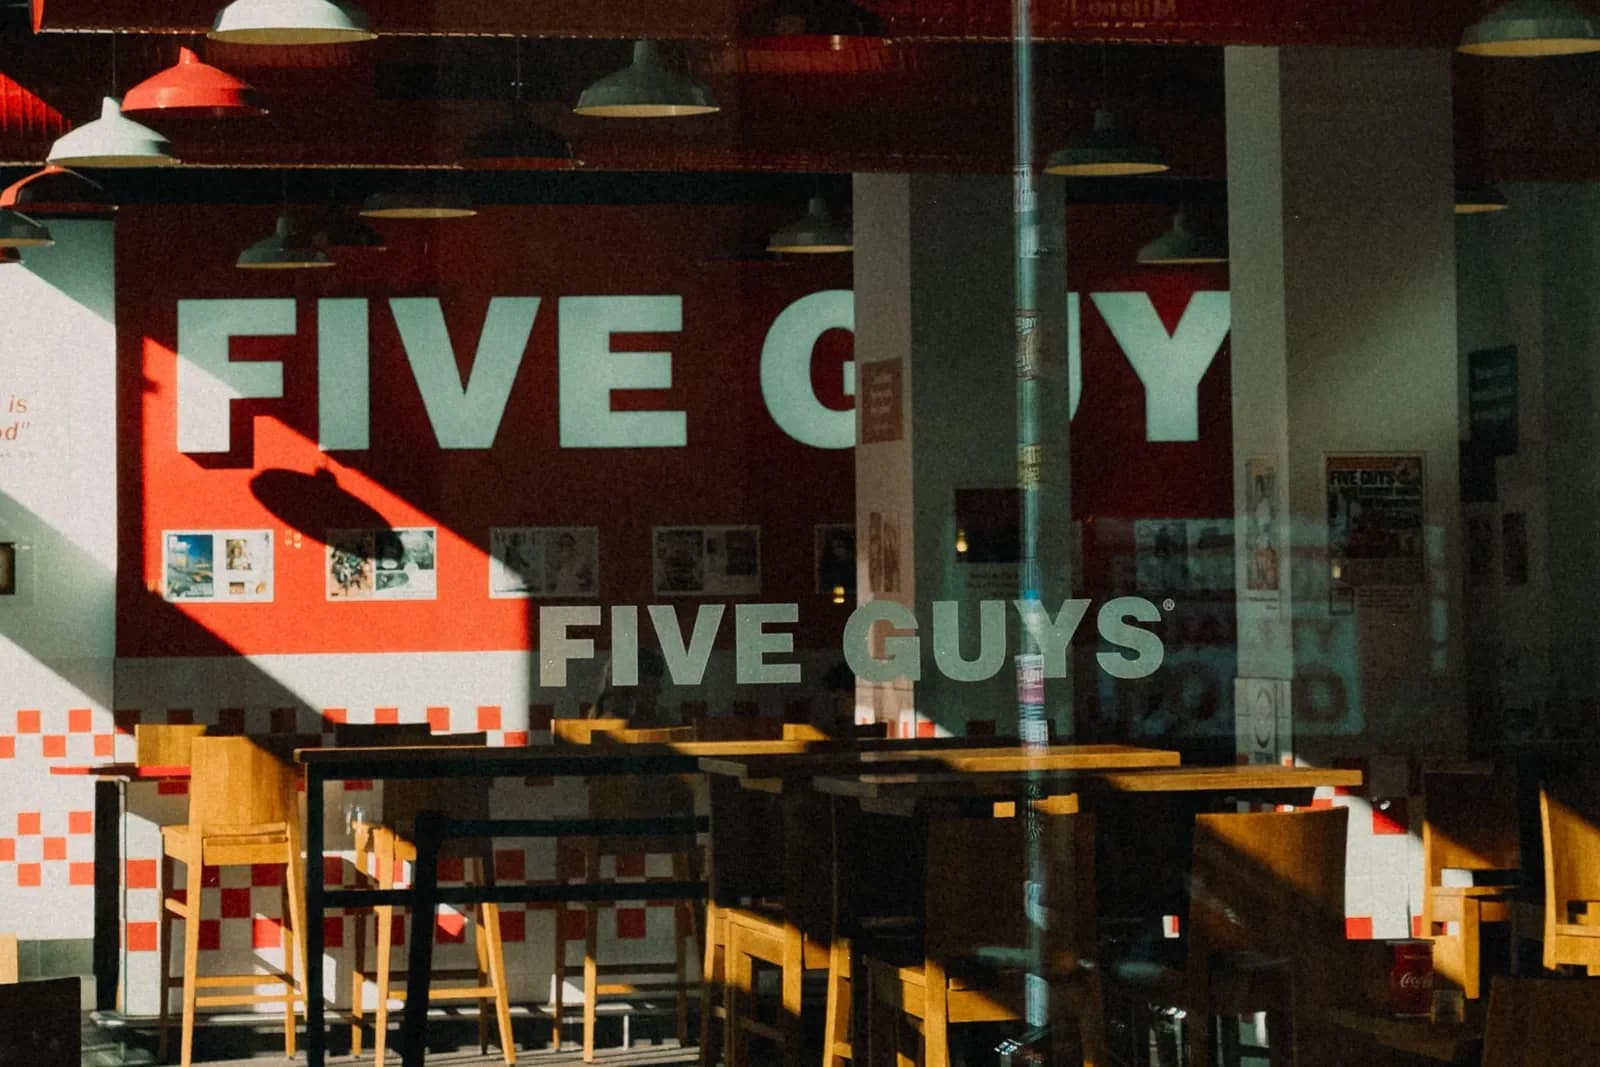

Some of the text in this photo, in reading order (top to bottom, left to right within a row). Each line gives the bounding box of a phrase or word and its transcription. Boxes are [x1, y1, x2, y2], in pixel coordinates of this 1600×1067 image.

[9, 394, 28, 413] is
[177, 295, 688, 453] FIVE
[760, 289, 1231, 449] GY
[538, 603, 803, 688] FIVE
